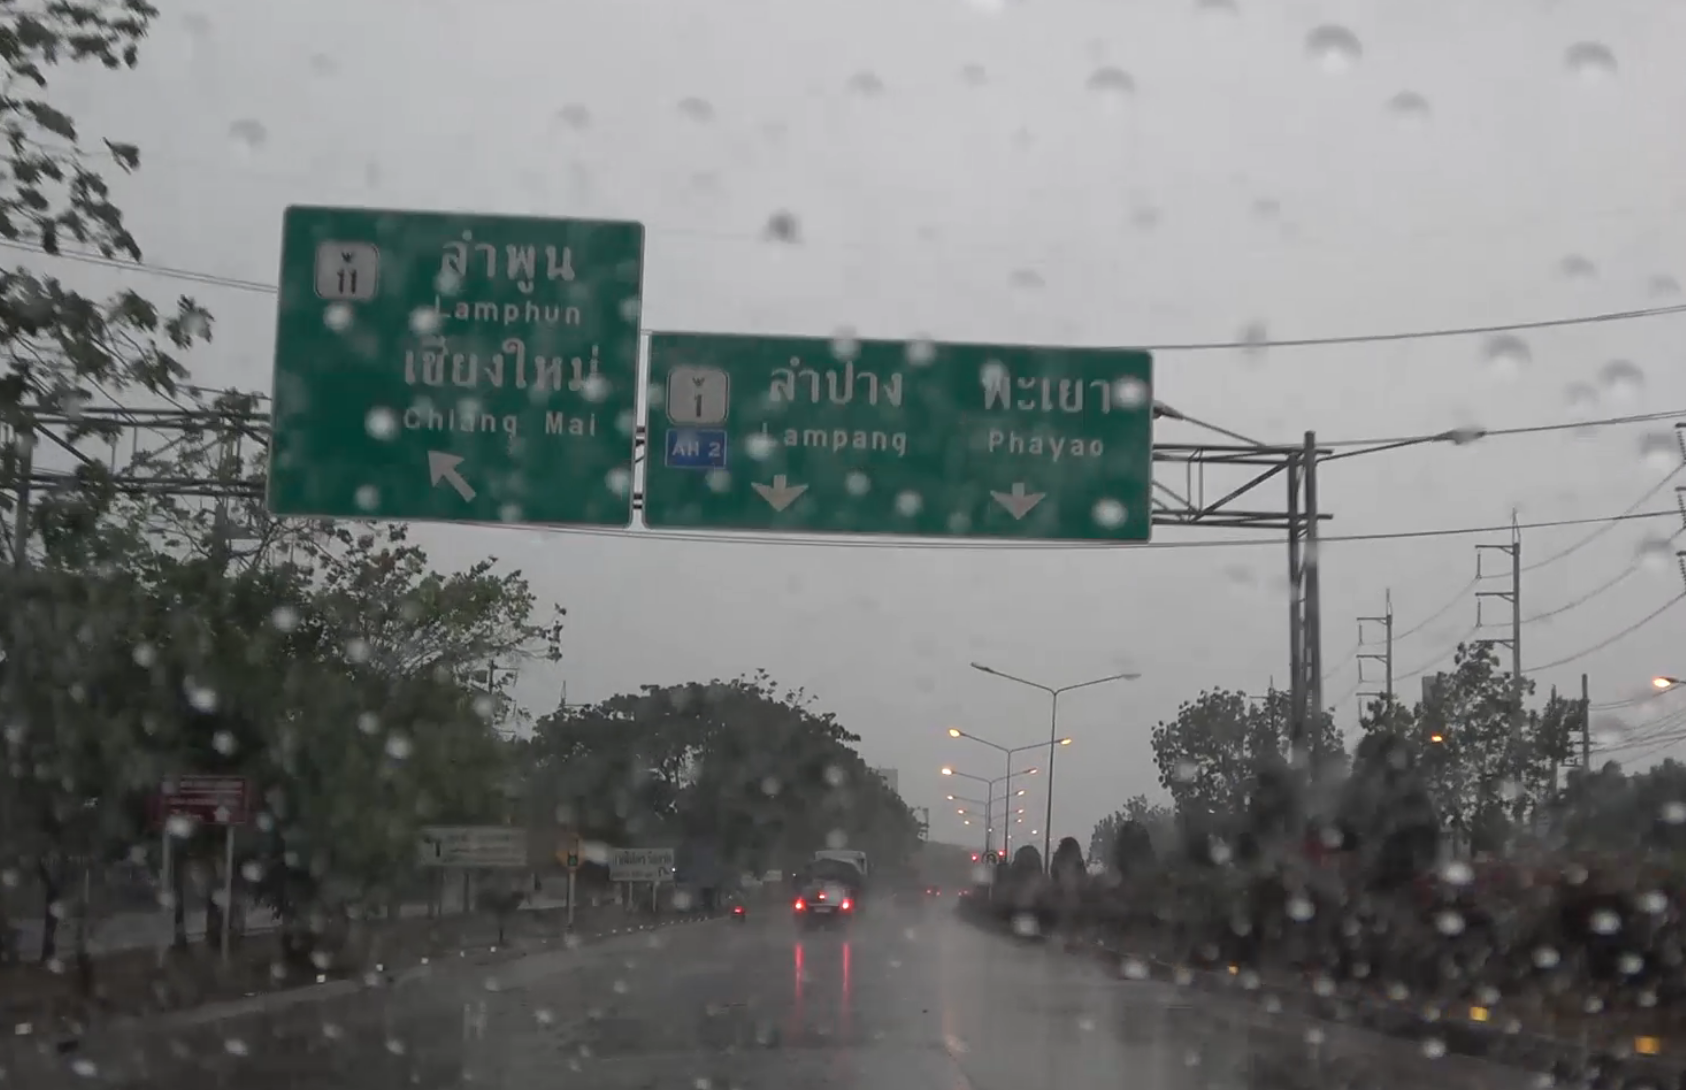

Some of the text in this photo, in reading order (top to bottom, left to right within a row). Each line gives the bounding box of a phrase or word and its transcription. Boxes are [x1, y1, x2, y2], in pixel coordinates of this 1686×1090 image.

[441, 229, 575, 293] ลำพูน
[337, 269, 357, 294] 11
[433, 294, 581, 326] Lamphun
[769, 356, 903, 407] ลำปาง
[693, 394, 702, 418] 1
[545, 411, 596, 436] Mai
[671, 441, 721, 457] AH 2
[989, 430, 1104, 462] Phayao
